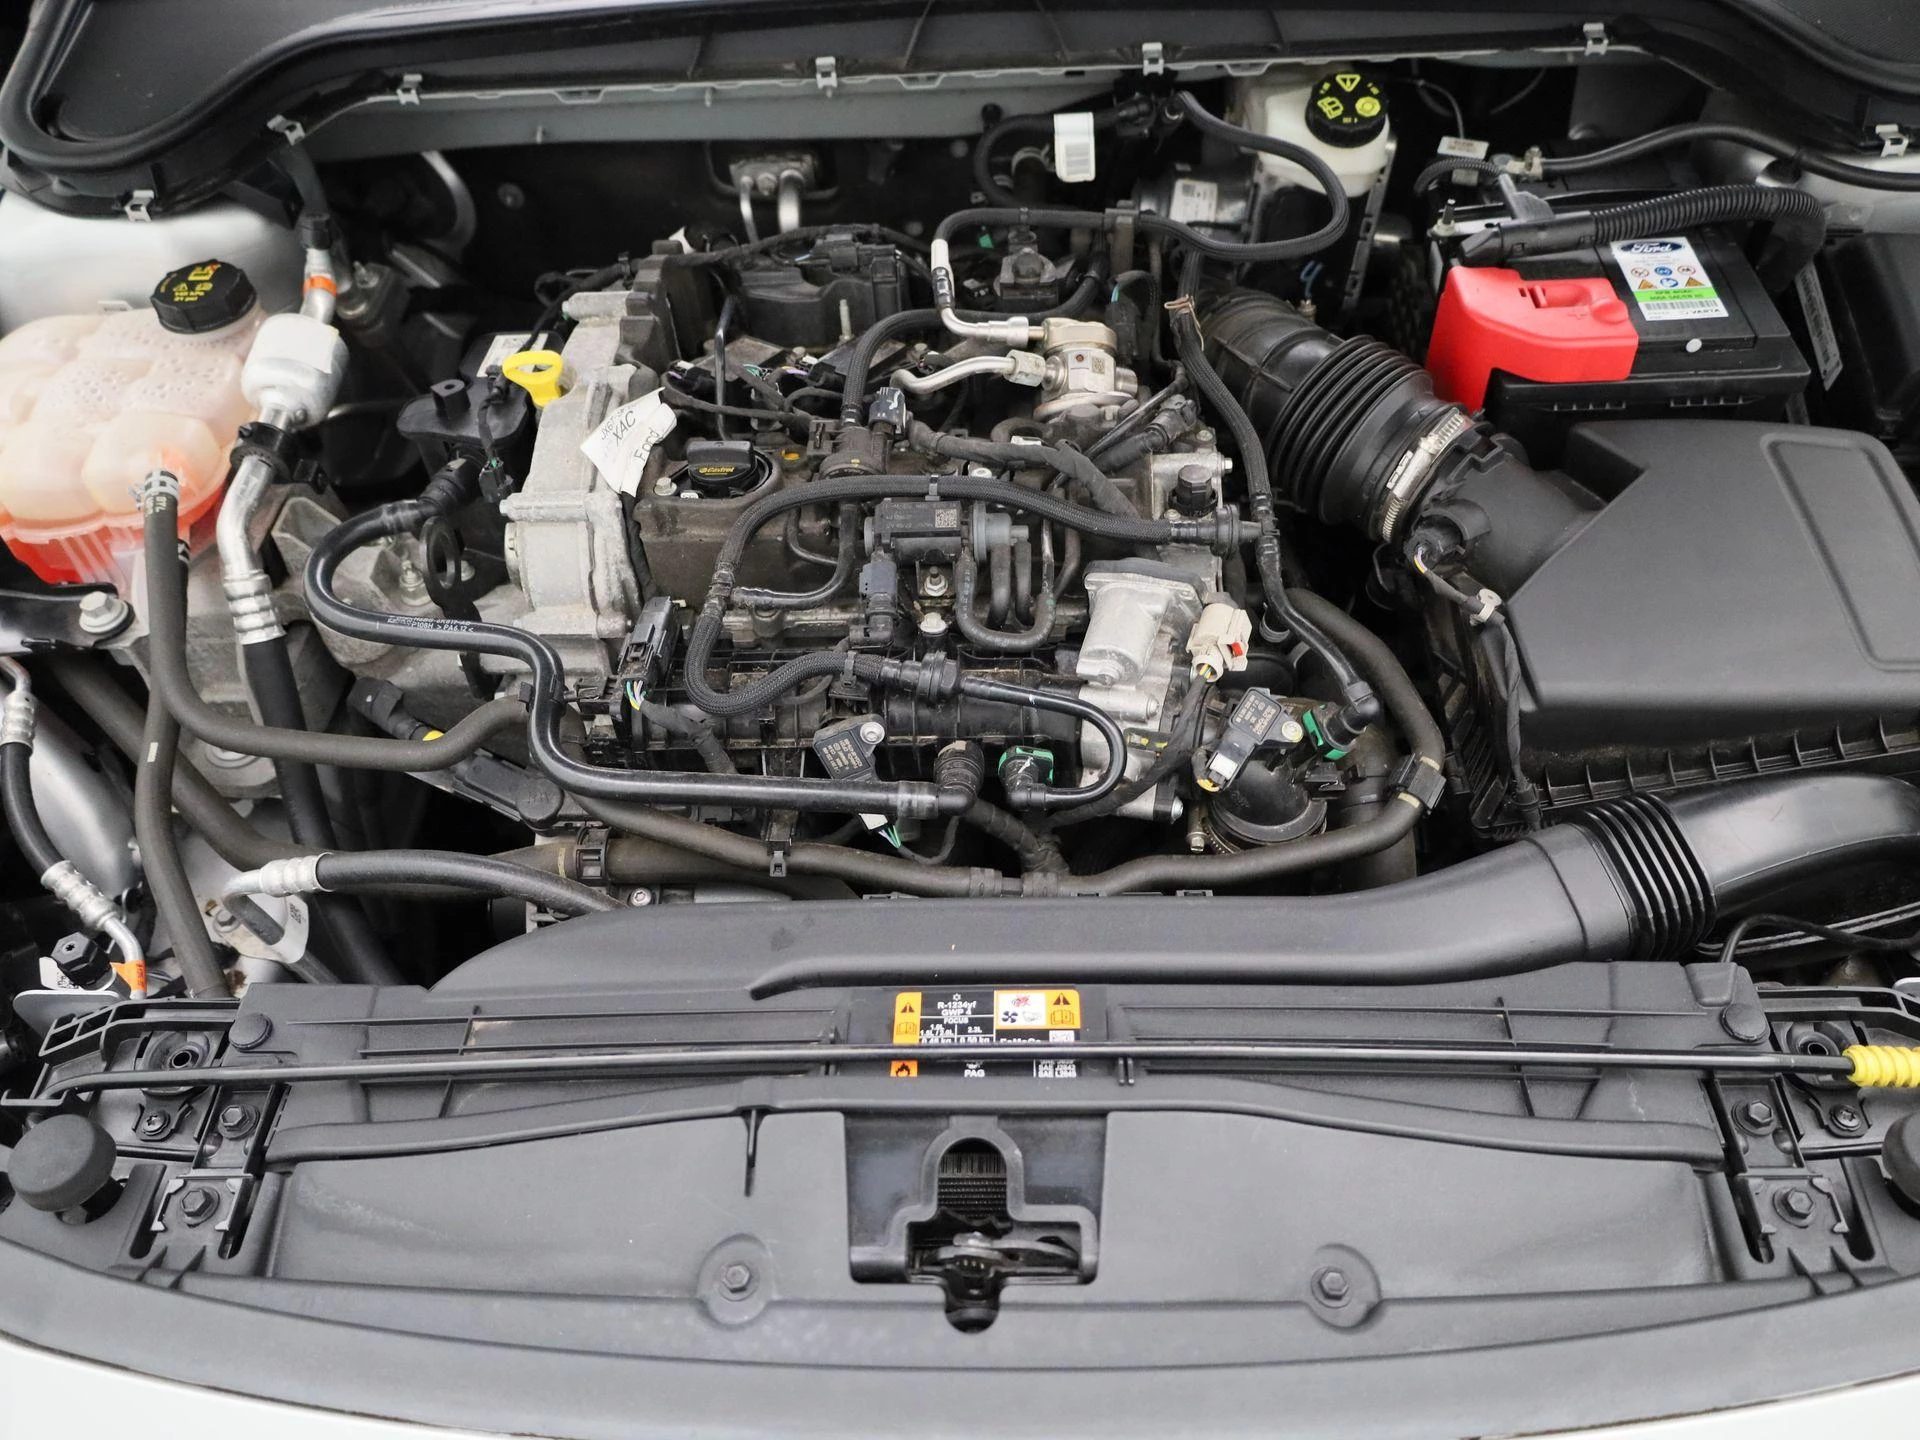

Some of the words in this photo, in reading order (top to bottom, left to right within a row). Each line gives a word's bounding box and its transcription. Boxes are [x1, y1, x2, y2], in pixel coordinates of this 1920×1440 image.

[1630, 241, 1674, 256] Ford
[612, 410, 636, 447] XAC
[937, 1000, 977, 1011] R-1234yf
[964, 1069, 985, 1078] PAG
